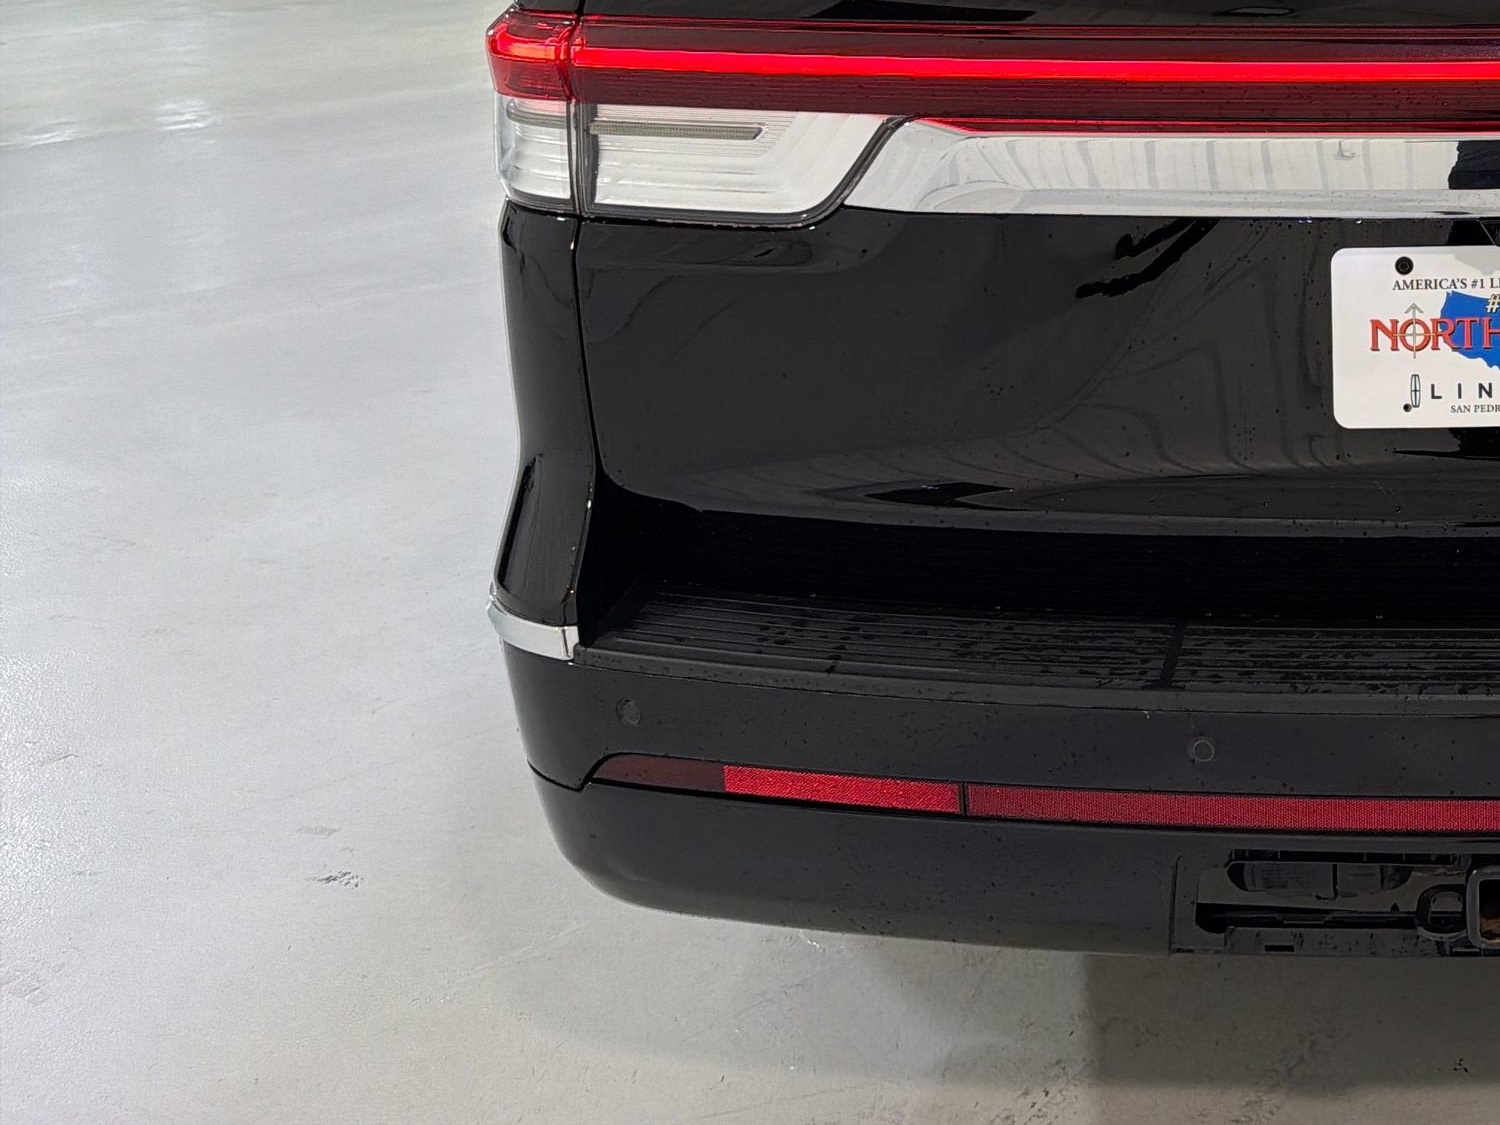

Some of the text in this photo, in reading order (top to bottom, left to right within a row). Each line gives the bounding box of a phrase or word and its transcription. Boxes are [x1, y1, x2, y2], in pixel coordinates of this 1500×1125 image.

[1392, 278, 1467, 290] AMERICA'S
[1470, 277, 1485, 289] #1
[1450, 404, 1471, 414] SAN
